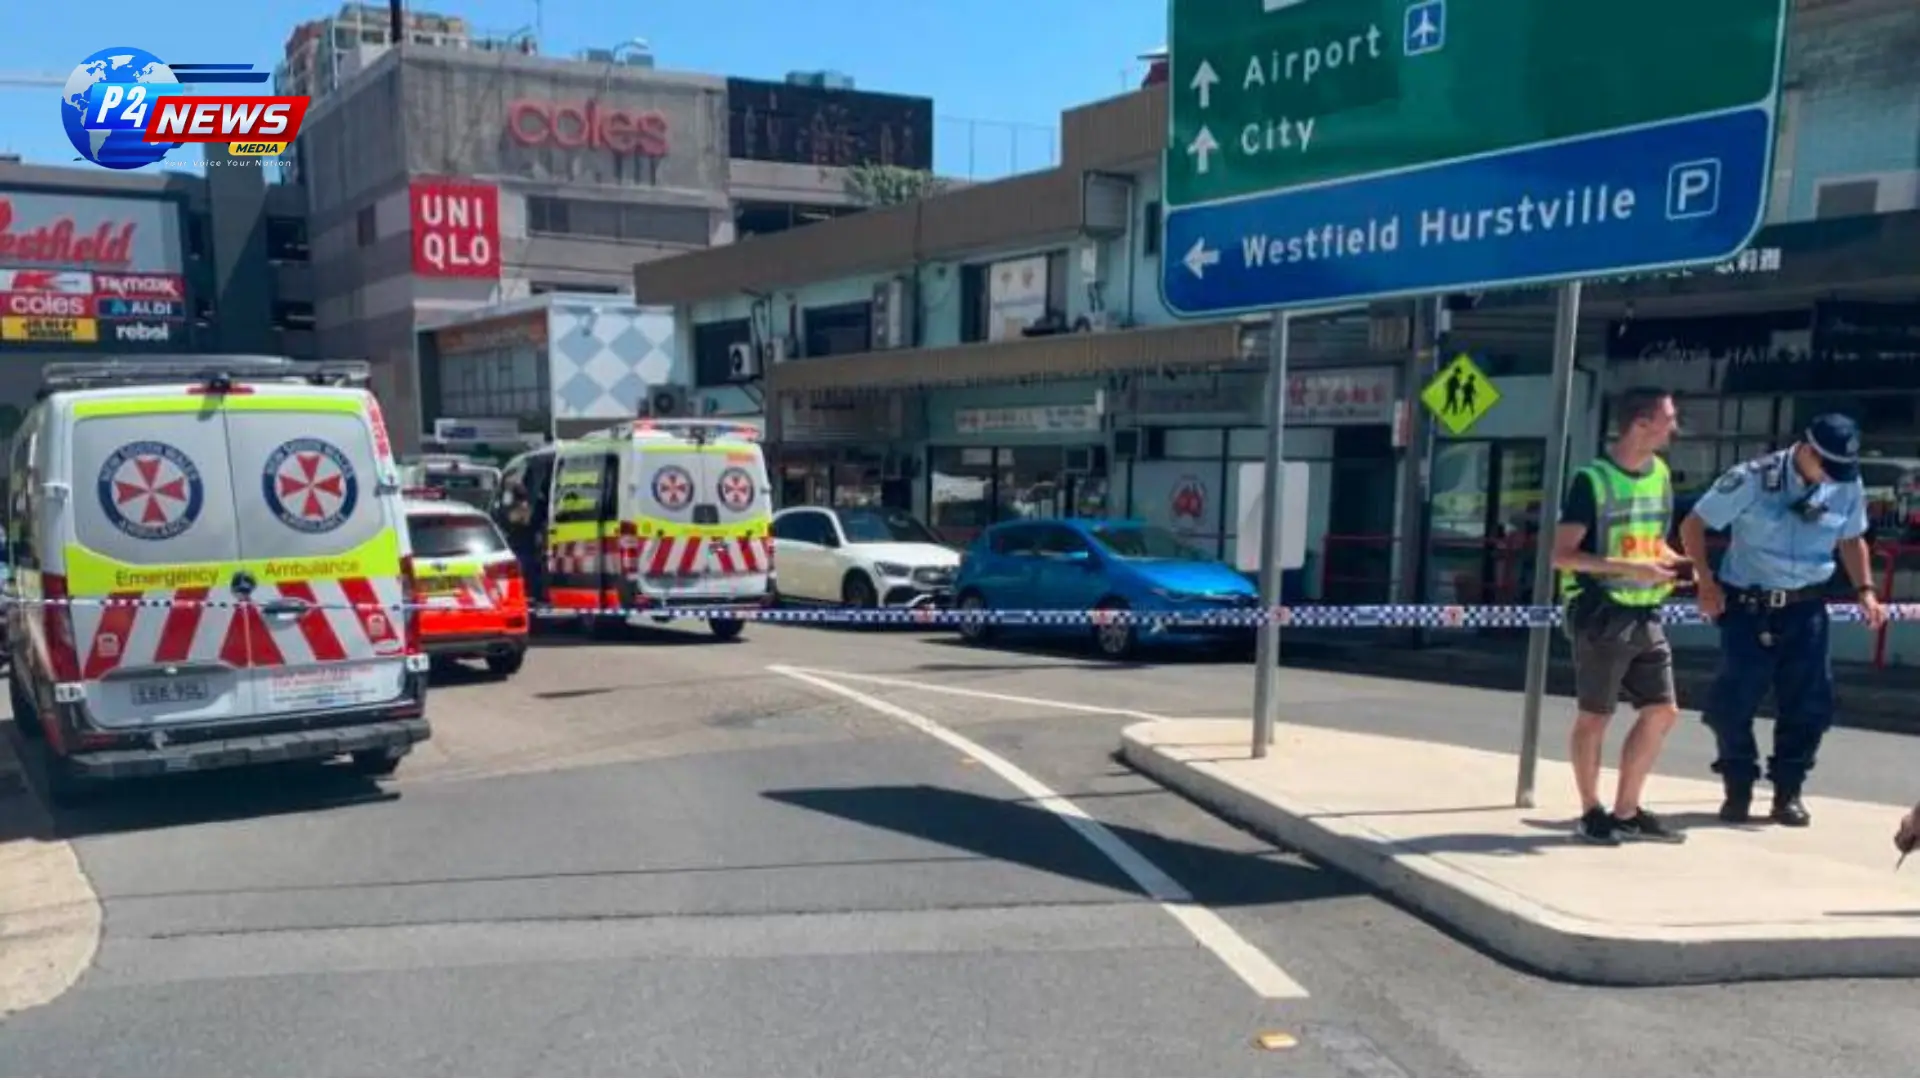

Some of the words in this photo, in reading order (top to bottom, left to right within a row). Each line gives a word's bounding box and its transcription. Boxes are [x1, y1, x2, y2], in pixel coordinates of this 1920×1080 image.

[1243, 28, 1380, 90] Airport
[510, 99, 668, 156] coles
[1241, 117, 1315, 154] City
[1676, 170, 1711, 211] P
[421, 194, 484, 228] UNI
[1243, 217, 1399, 269] Westfield
[1420, 184, 1636, 246] Hurstville
[423, 233, 491, 269] QLO
[11, 292, 85, 314] coles
[131, 302, 173, 314] ALDI
[116, 322, 169, 340] rebel
[115, 568, 219, 587] Emergency
[264, 560, 359, 577] Ambulance
